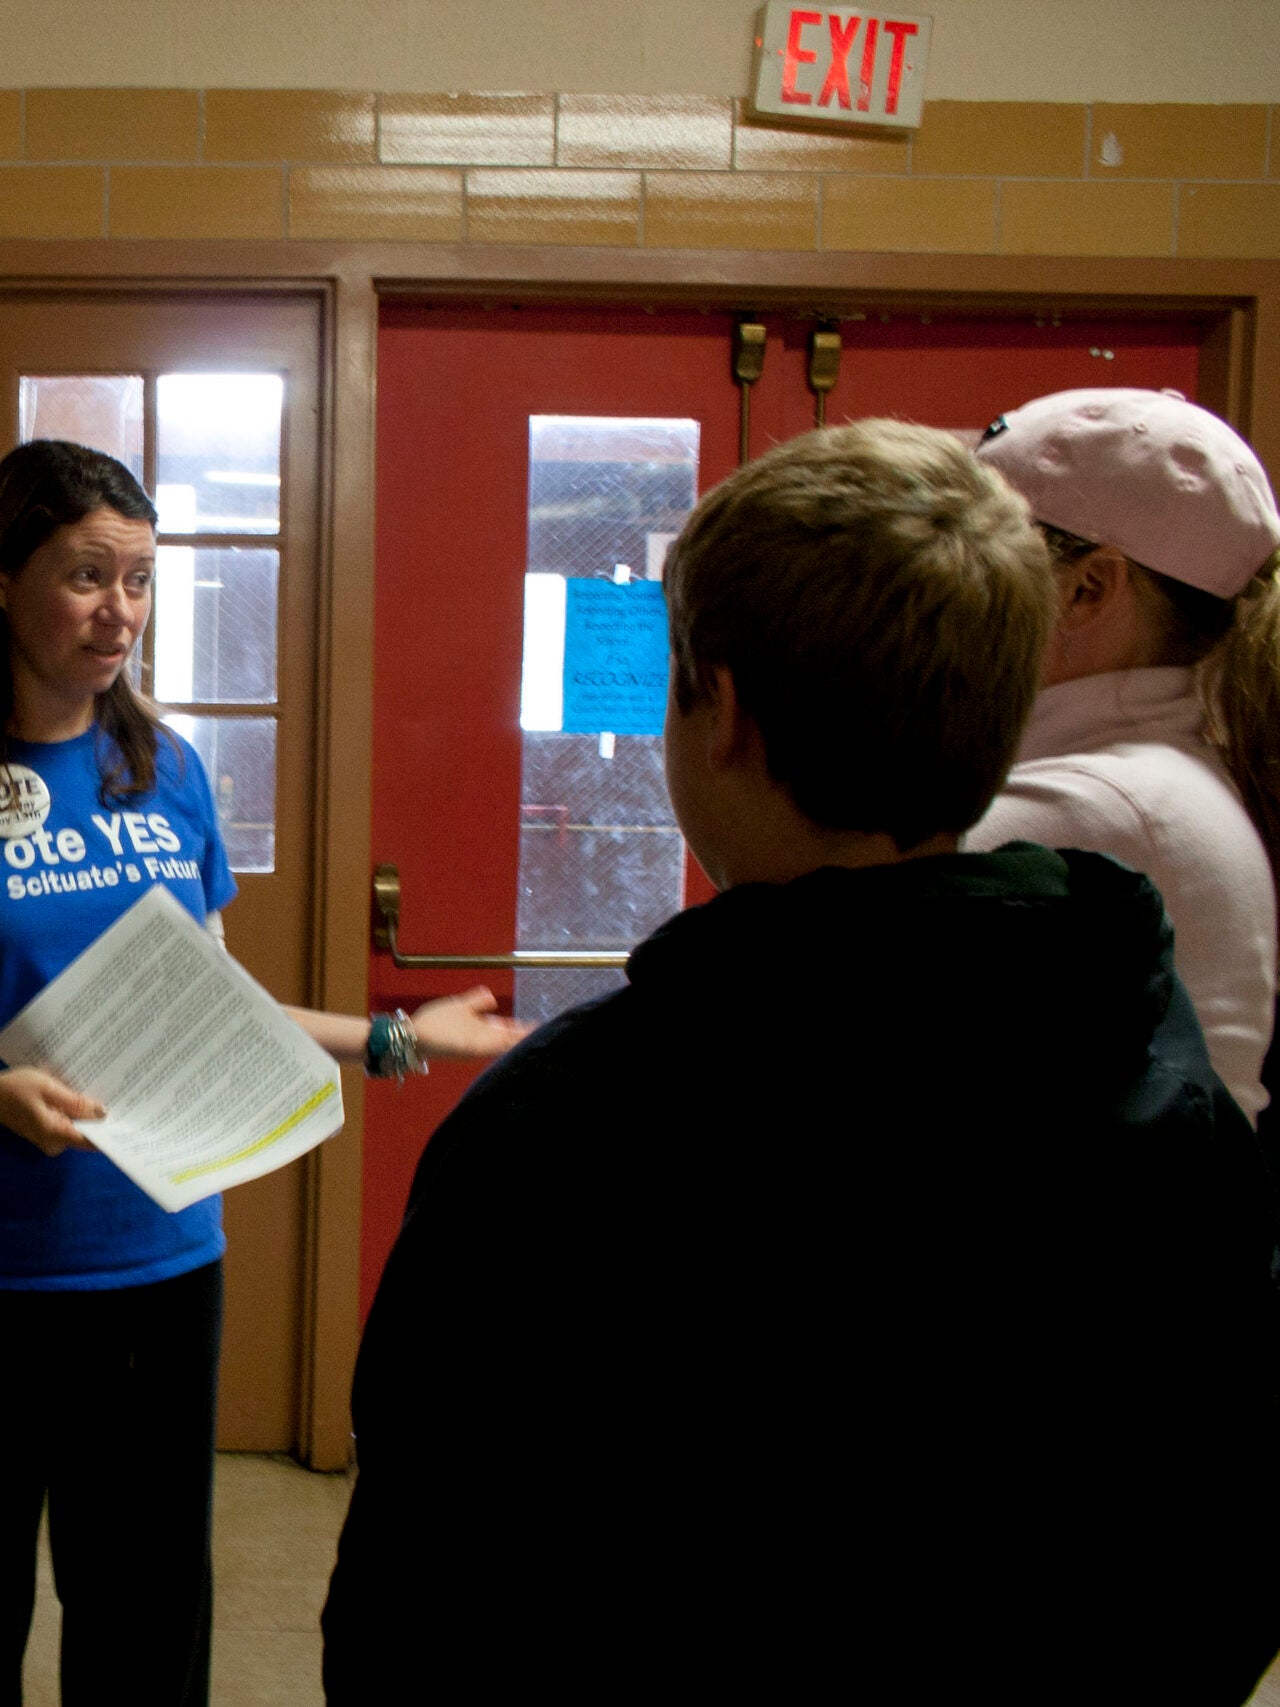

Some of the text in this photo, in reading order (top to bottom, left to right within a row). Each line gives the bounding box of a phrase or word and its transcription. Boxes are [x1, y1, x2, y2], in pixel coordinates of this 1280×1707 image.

[780, 8, 919, 116] EXIT
[573, 671, 668, 687] RECOGNIZE
[91, 813, 181, 855] YES
[144, 857, 201, 880] Futur
